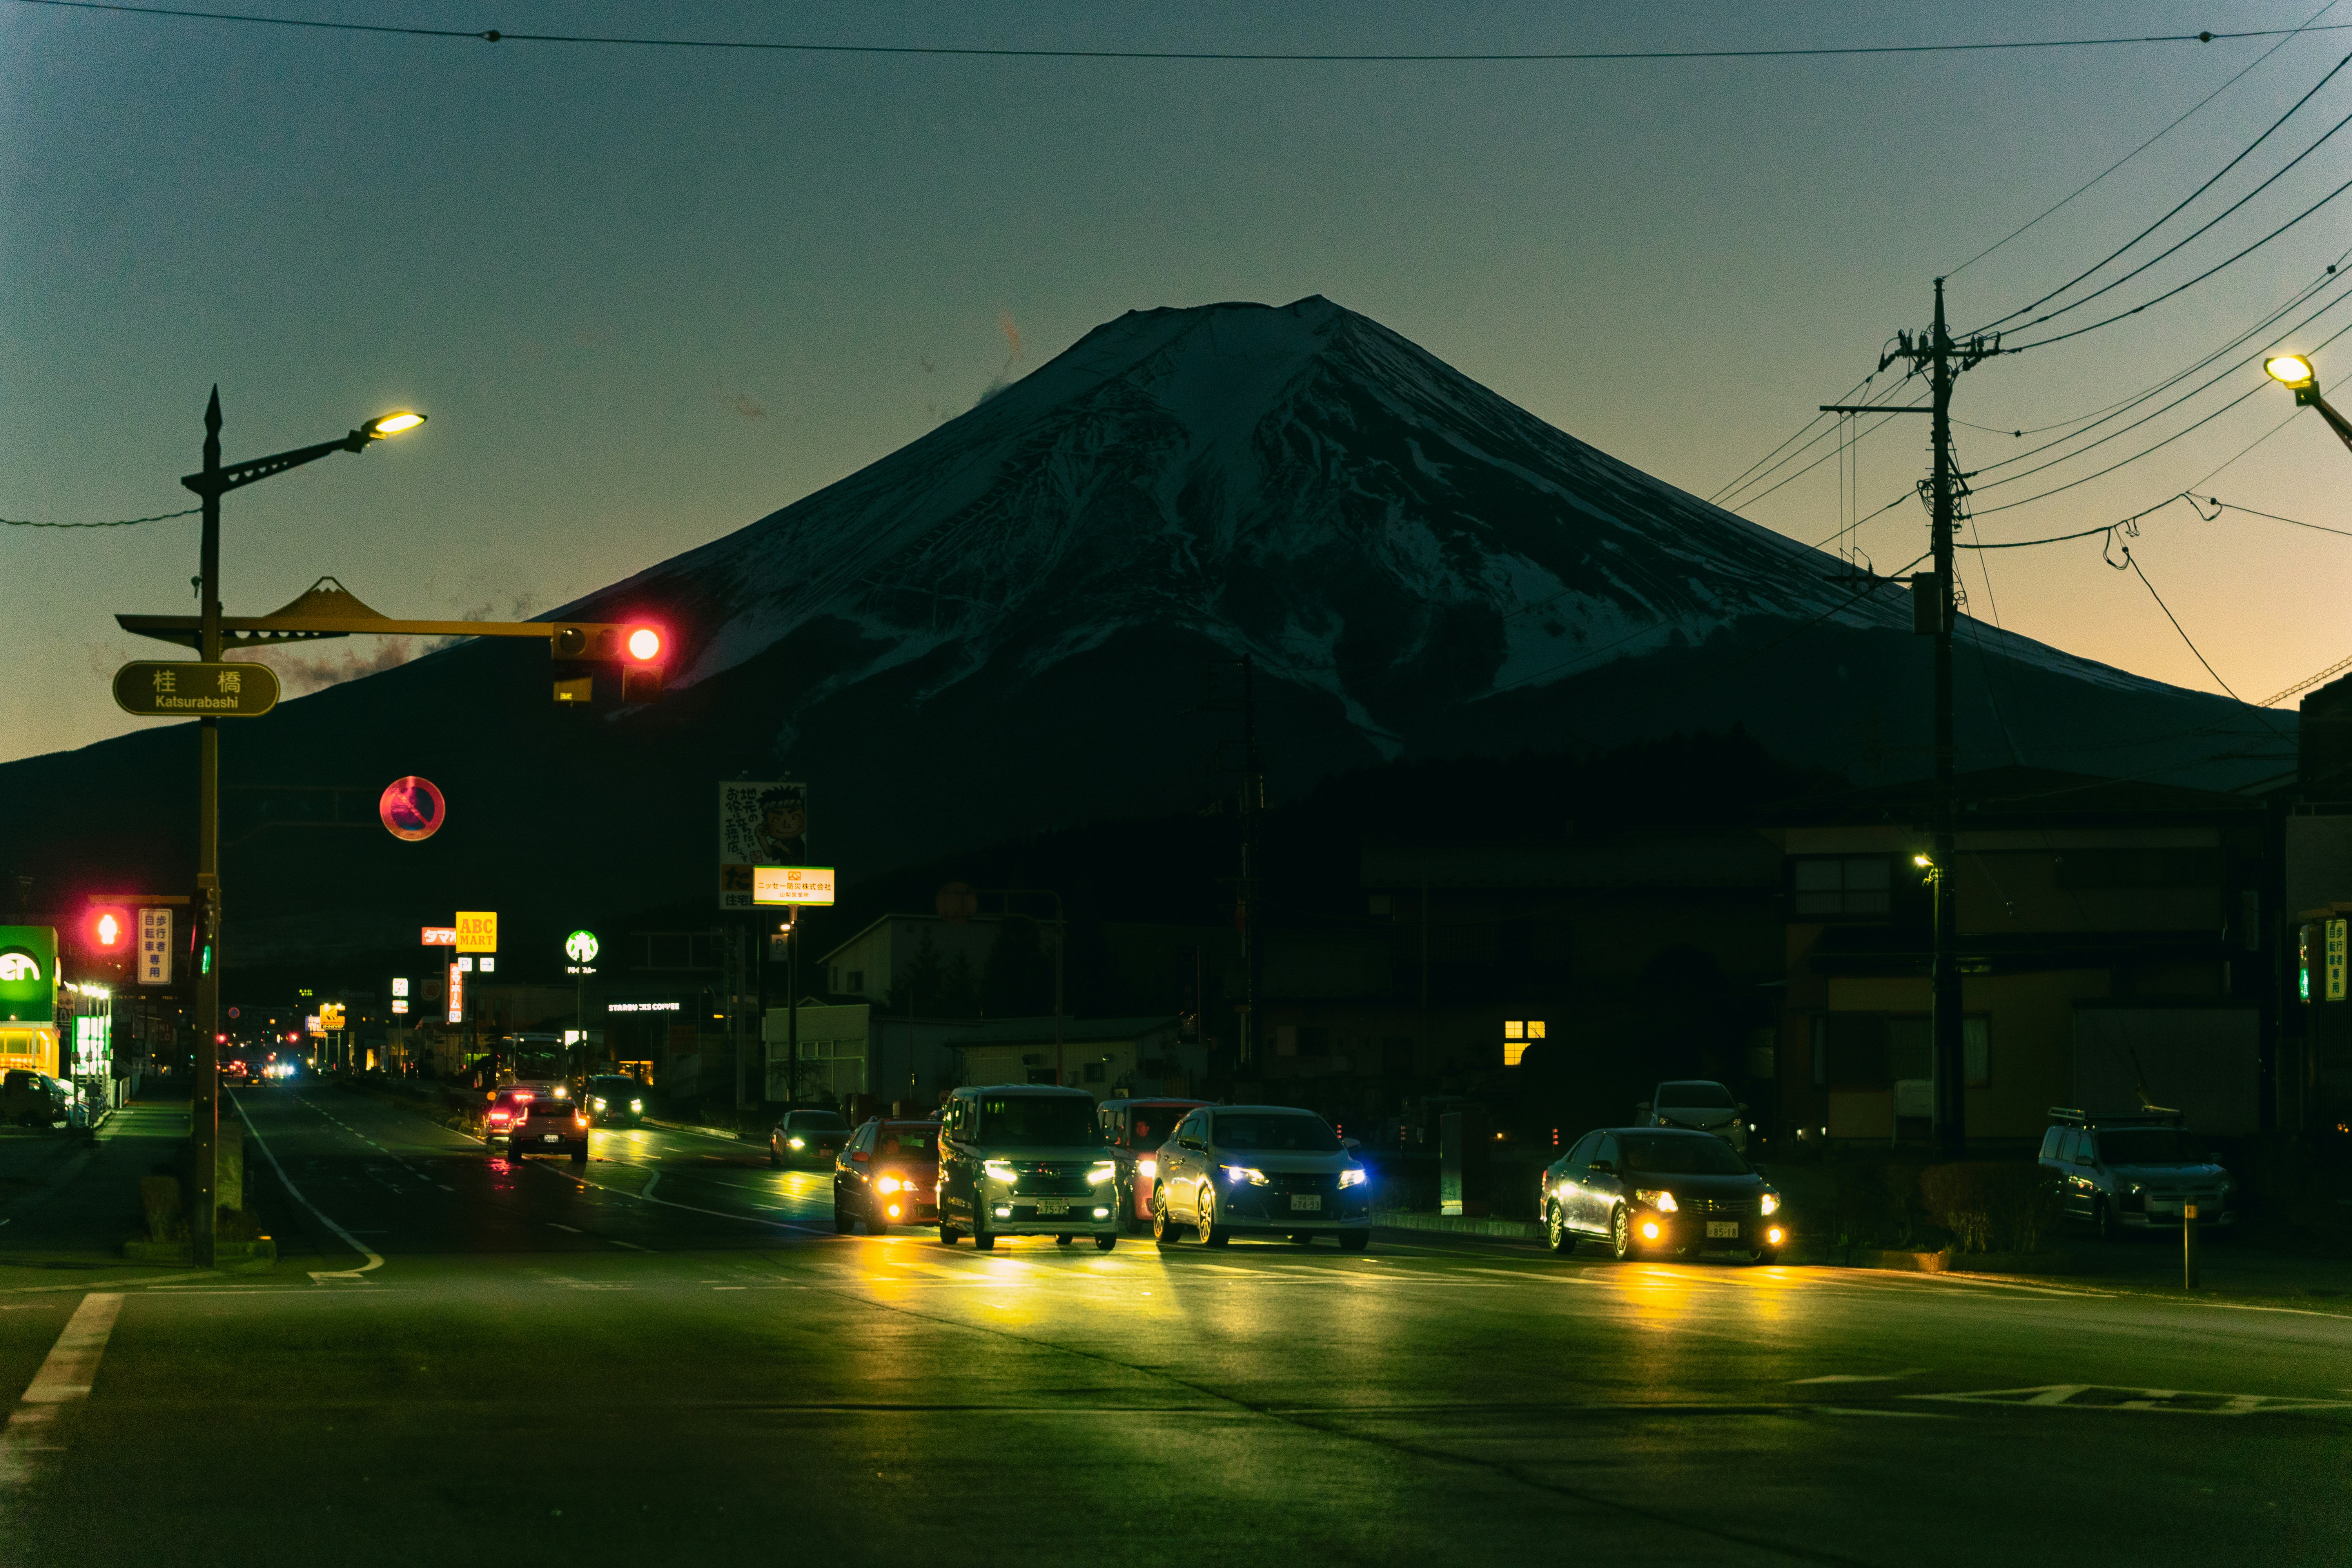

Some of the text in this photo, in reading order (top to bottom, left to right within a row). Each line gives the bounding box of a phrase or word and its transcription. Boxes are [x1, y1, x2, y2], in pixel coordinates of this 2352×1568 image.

[153, 670, 241, 693] 桂橋
[156, 695, 238, 708] Katsurabashi
[740, 787, 758, 822] 地元の
[758, 882, 831, 891] ニッセー防災株式会社
[460, 918, 493, 934] ABC
[145, 916, 154, 951] 自転車
[156, 915, 166, 952] 歩行者
[460, 935, 493, 945] MART
[775, 939, 783, 949] P
[149, 954, 160, 977] 専用
[462, 960, 468, 969] P
[450, 966, 460, 1009] タマホーム
[2333, 969, 2339, 993] 専用
[451, 1013, 456, 1021] P
[1044, 1205, 1067, 1214] 75-75
[1298, 1201, 1319, 1209] 74-93
[1714, 1228, 1737, 1237] 85-18
